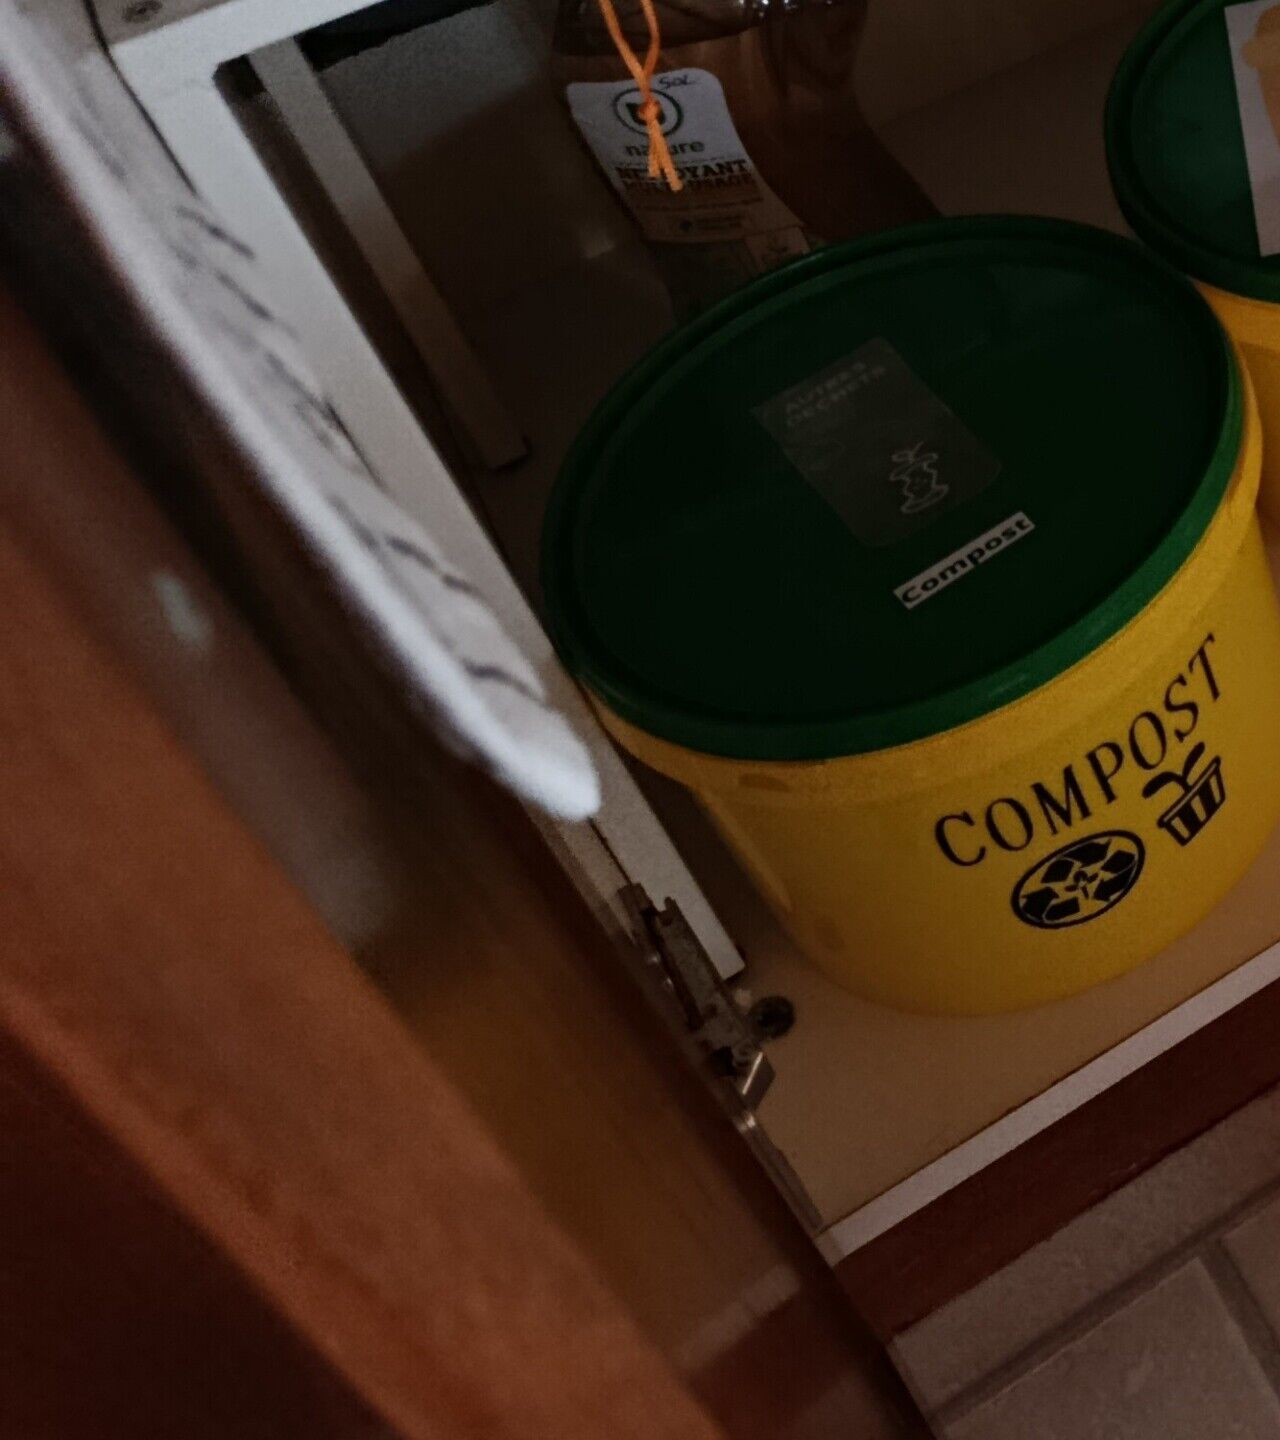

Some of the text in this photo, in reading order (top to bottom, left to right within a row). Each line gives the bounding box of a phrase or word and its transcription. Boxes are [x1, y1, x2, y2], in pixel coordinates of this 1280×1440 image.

[625, 142, 704, 156] naure
[902, 517, 1032, 603] Compost
[934, 634, 1220, 866] COMPOST
